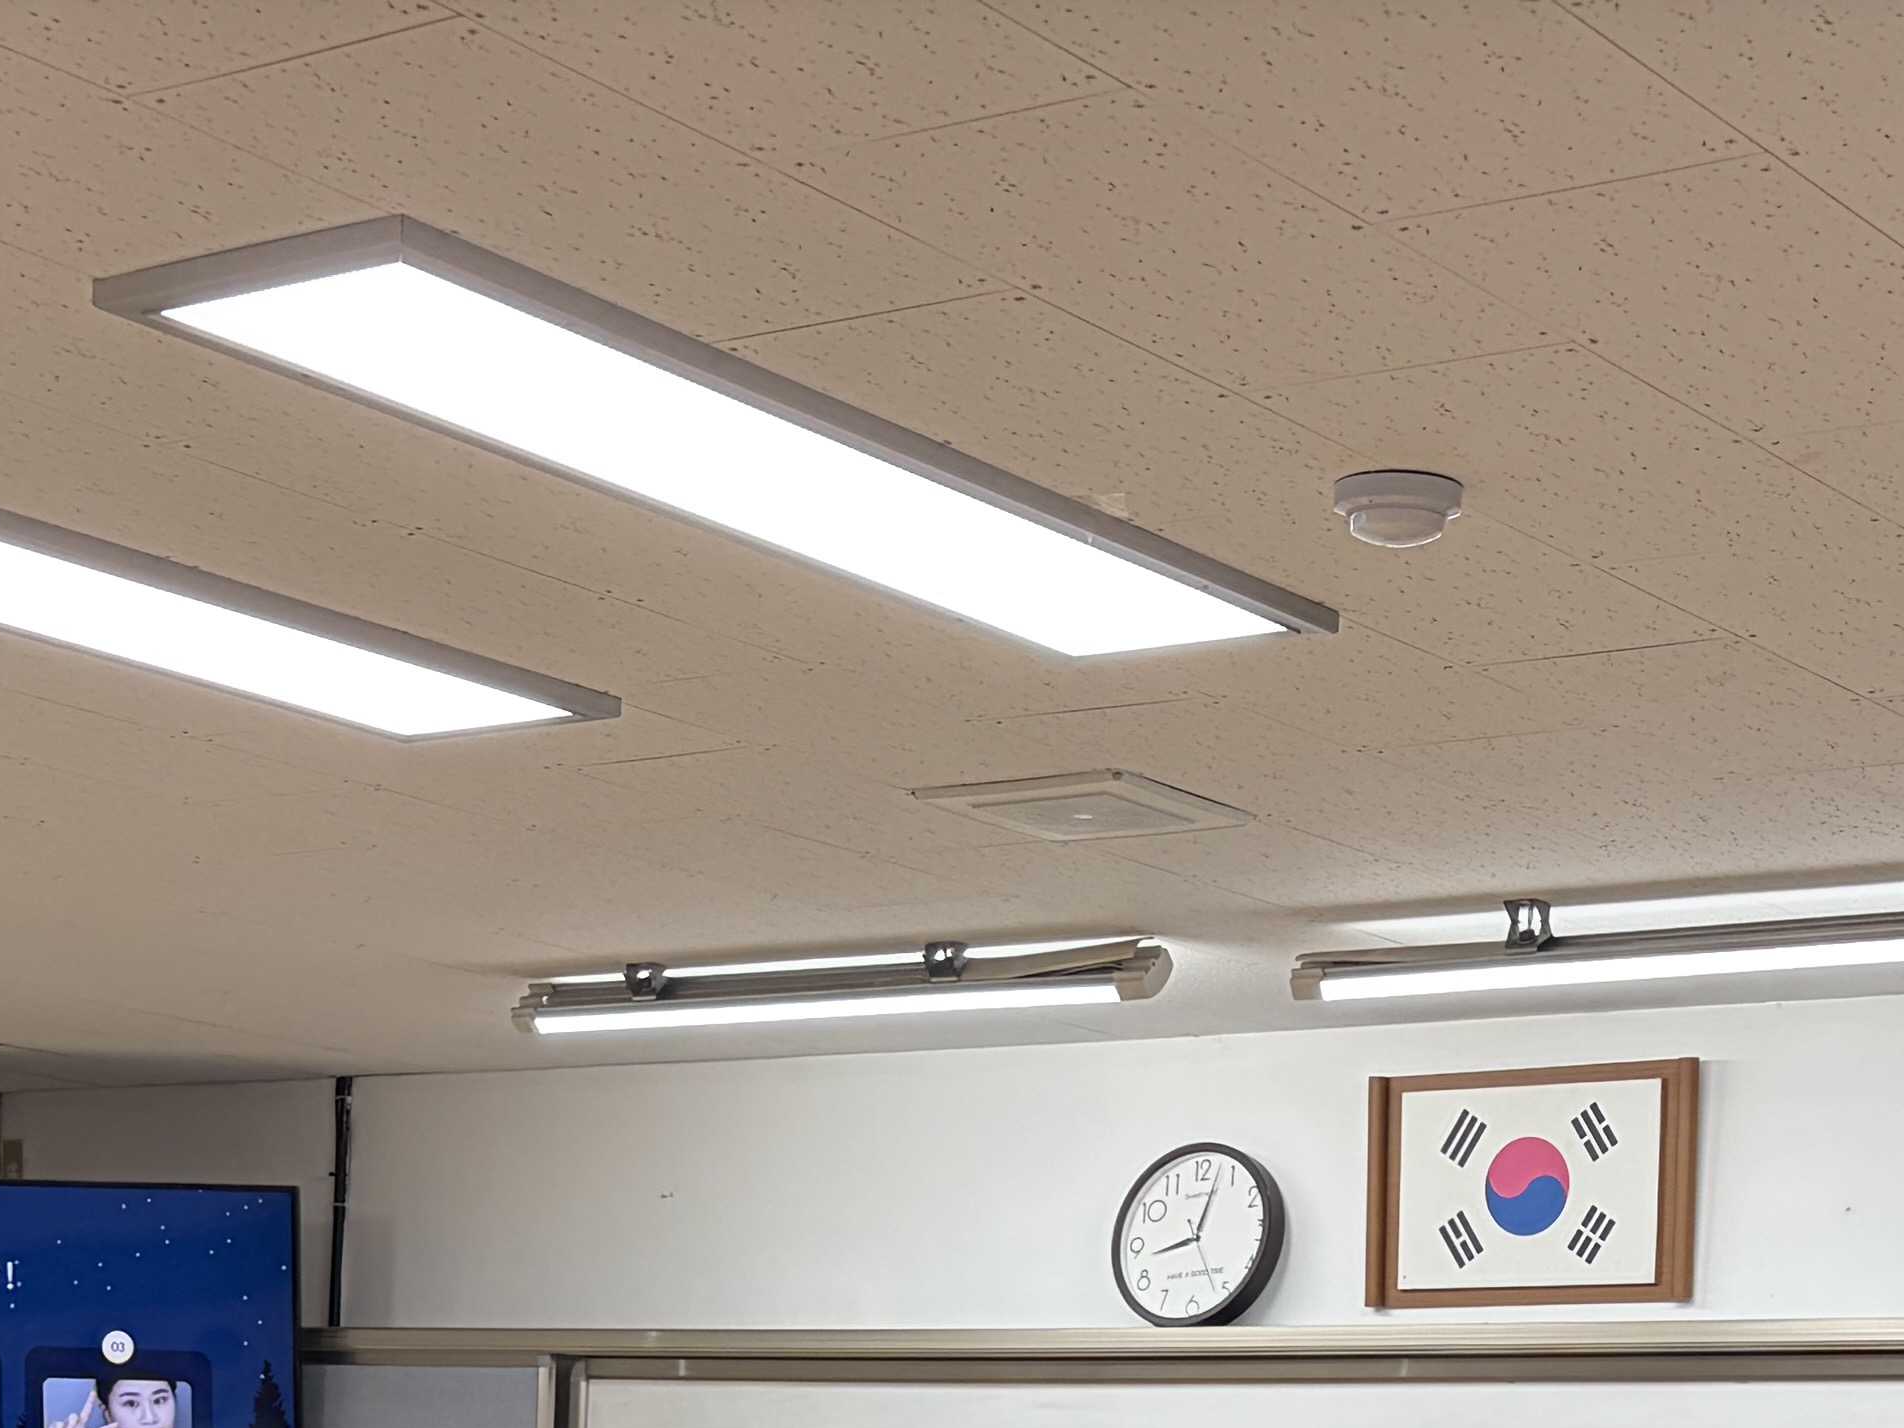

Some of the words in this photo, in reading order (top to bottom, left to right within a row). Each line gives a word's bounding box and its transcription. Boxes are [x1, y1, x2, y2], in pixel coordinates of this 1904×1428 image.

[1195, 1158, 1212, 1182] 12
[1165, 1173, 1180, 1197] 11
[1142, 1199, 1168, 1224] 10
[1129, 1236, 1145, 1260] 9
[1136, 1268, 1151, 1292] 8
[1159, 1289, 1169, 1312] 7
[1184, 1294, 1200, 1317] 6
[110, 1341, 126, 1353] 03
